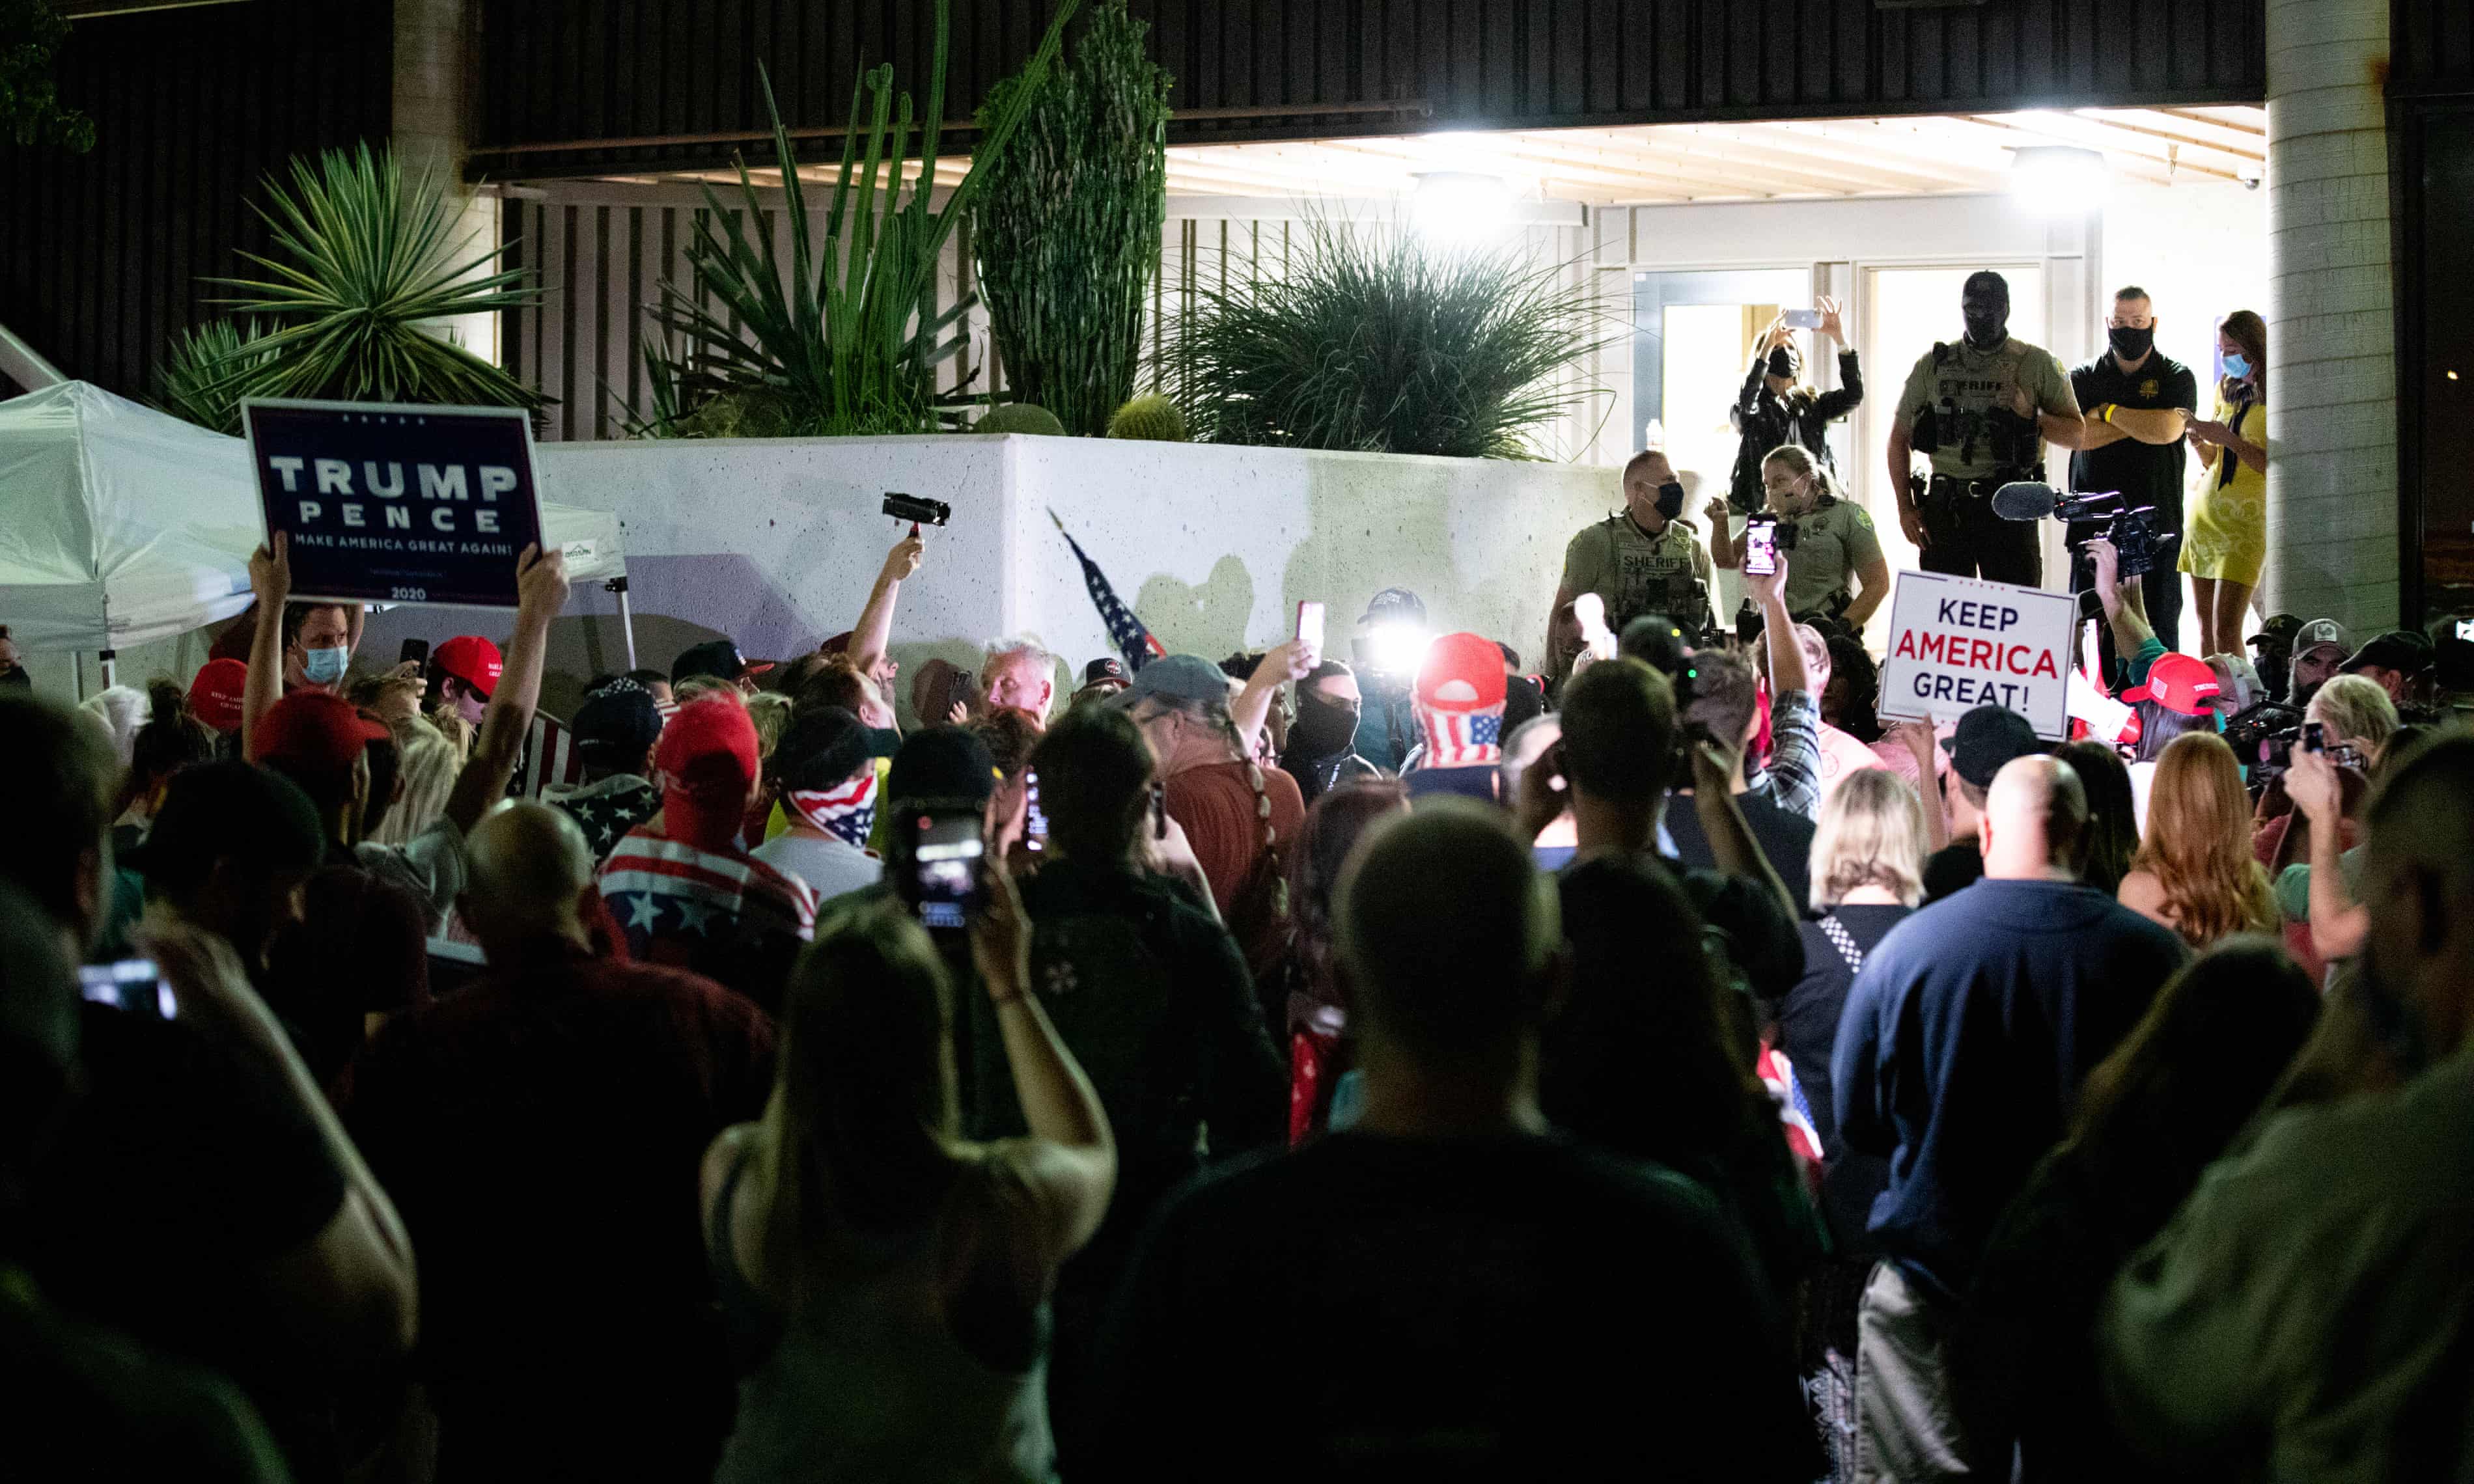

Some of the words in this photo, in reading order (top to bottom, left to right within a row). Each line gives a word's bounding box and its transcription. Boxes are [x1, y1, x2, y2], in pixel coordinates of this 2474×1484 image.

[269, 456, 518, 502] TRUMP
[299, 501, 501, 534] PENCE
[295, 532, 334, 547] MAKE
[339, 536, 404, 551] AMERICA
[408, 540, 455, 553] GREAT
[460, 542, 513, 556] AGAIN!
[1623, 555, 1689, 569] SHERIFF
[391, 586, 426, 600] 2020
[1938, 597, 2019, 632] KEEP
[1895, 628, 2058, 680] AMERICA
[1913, 672, 2029, 712] GREAT!
